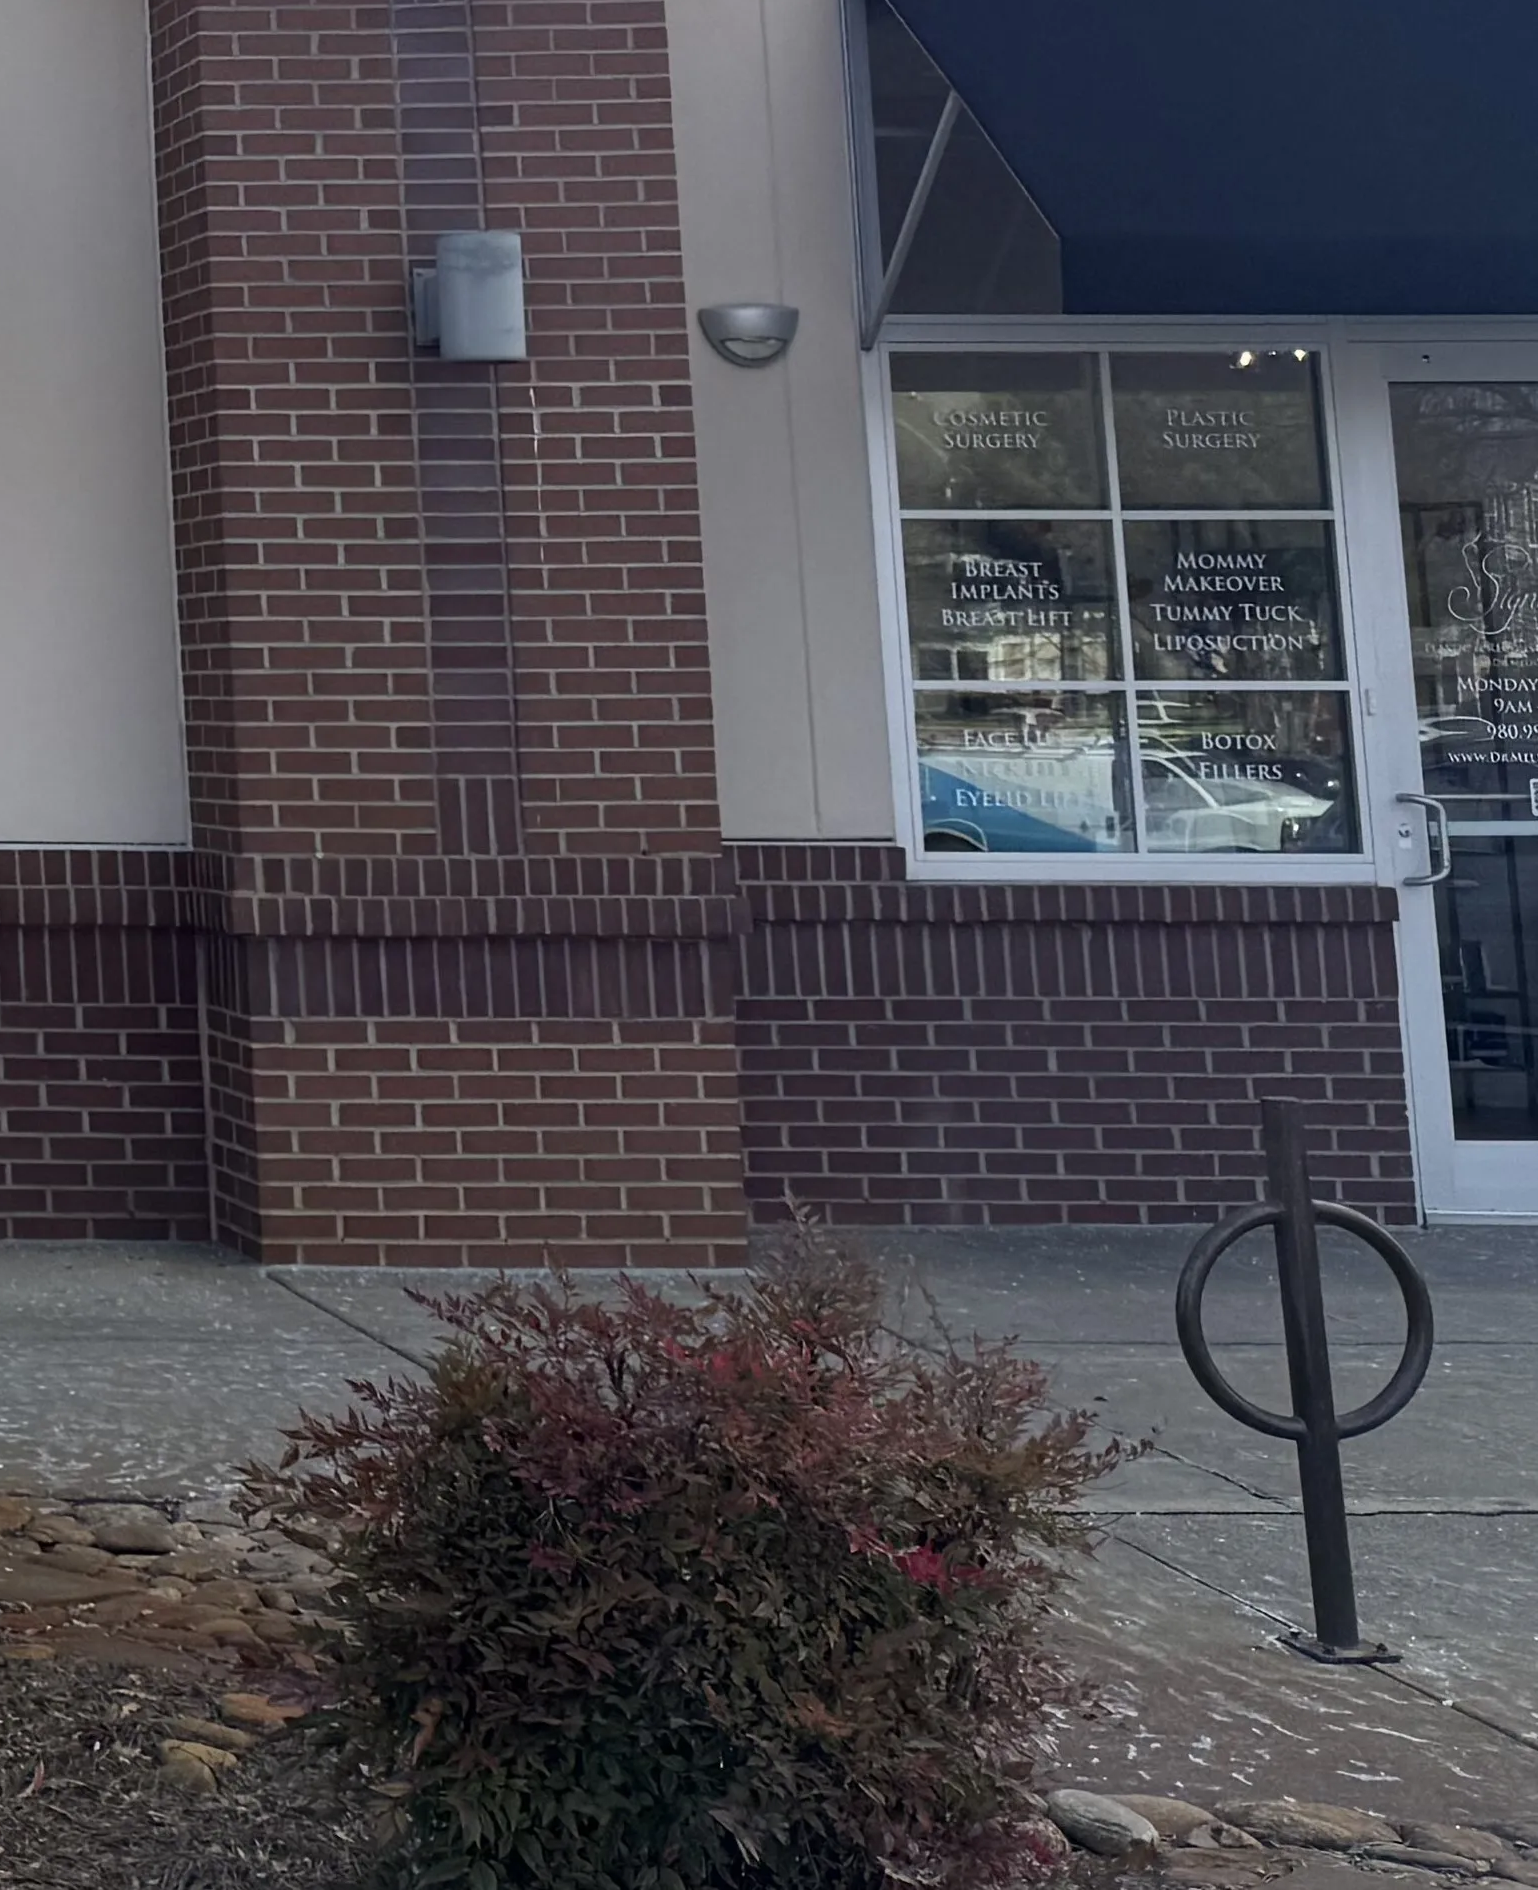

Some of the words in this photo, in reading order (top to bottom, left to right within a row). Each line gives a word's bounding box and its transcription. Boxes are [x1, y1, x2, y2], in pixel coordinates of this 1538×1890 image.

[933, 410, 1050, 427] COSMETIC
[1166, 409, 1255, 427] PLASTIC
[943, 432, 1041, 449] SURGERY
[1163, 431, 1261, 449] SURGERY
[965, 560, 1043, 578] BREAST
[1177, 552, 1267, 570] MOMMY
[951, 582, 1061, 600] IMPLANTS
[1164, 574, 1285, 592] MAKEOVER
[942, 609, 1023, 627] BREAST
[1027, 609, 1073, 627] LIFT
[1149, 603, 1233, 622] TUMMY
[1239, 603, 1306, 622] TUCK
[1154, 633, 1304, 651] LIPOSUCTION
[1201, 732, 1277, 750] BOTOX
[1199, 761, 1282, 780] FILLERS
[956, 789, 1032, 808] EYELID
